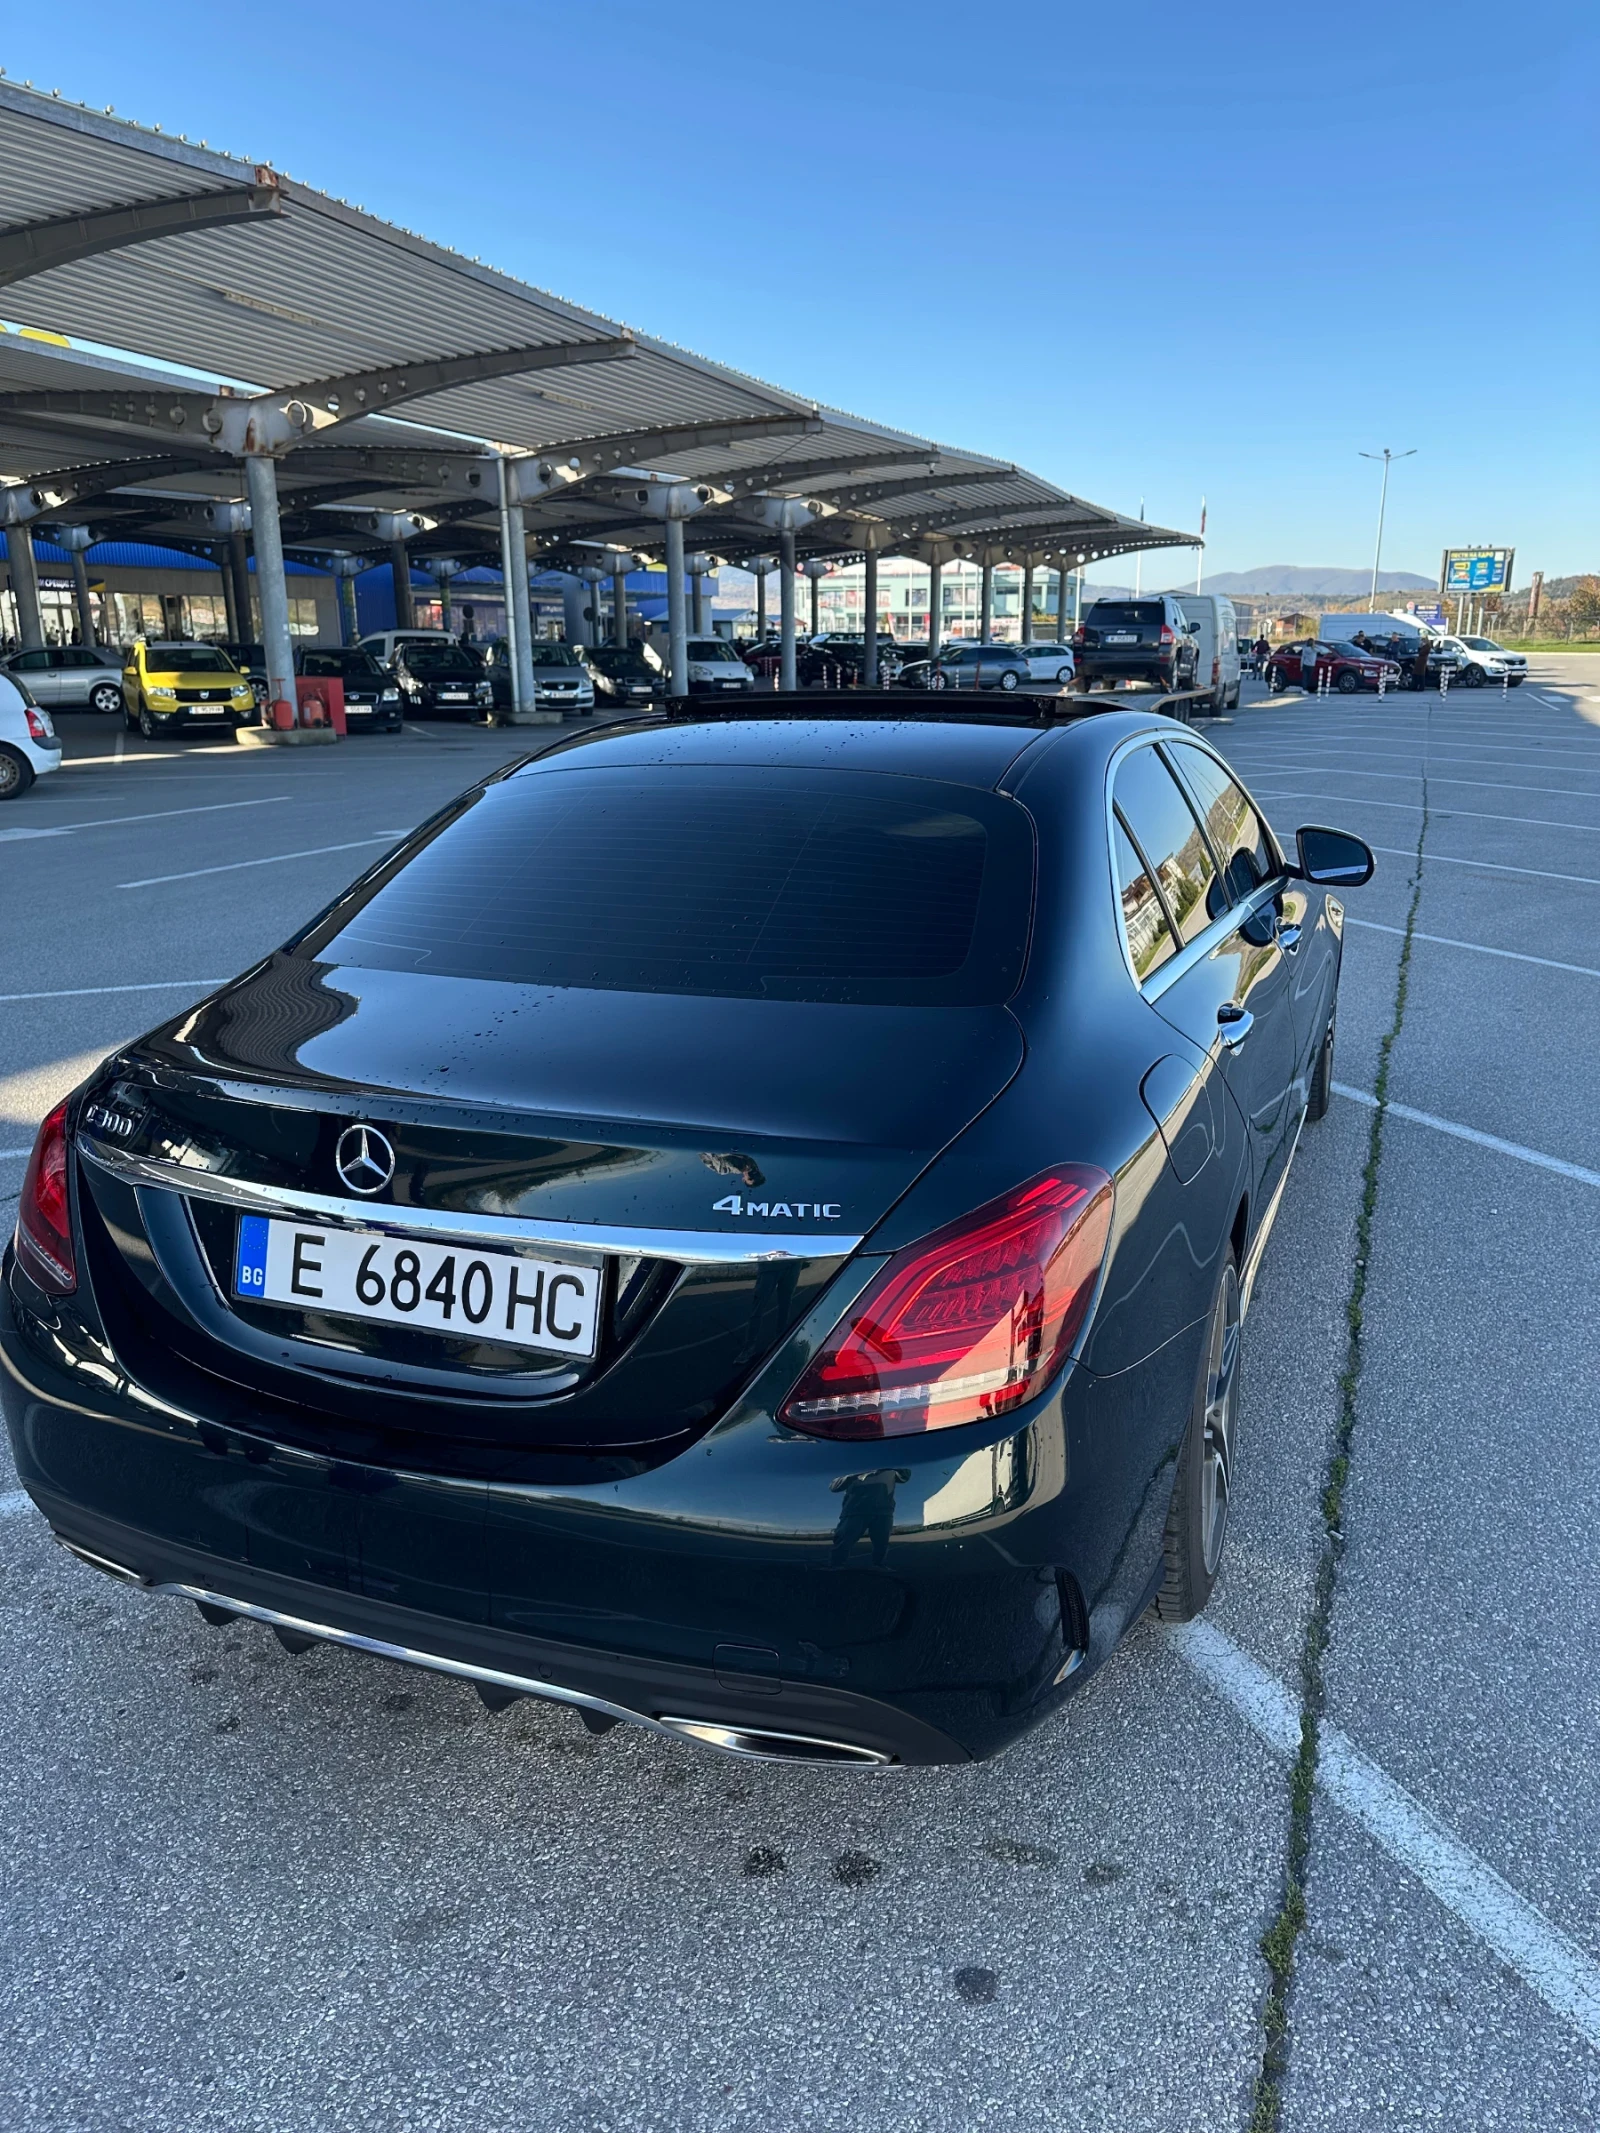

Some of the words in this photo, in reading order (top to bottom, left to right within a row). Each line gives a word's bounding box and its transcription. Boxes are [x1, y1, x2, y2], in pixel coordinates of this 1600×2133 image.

[712, 1194, 842, 1218] 4MATIC
[241, 1265, 263, 1286] BG
[290, 1232, 326, 1298] E
[355, 1243, 494, 1325] 6840
[506, 1265, 586, 1341] HC
